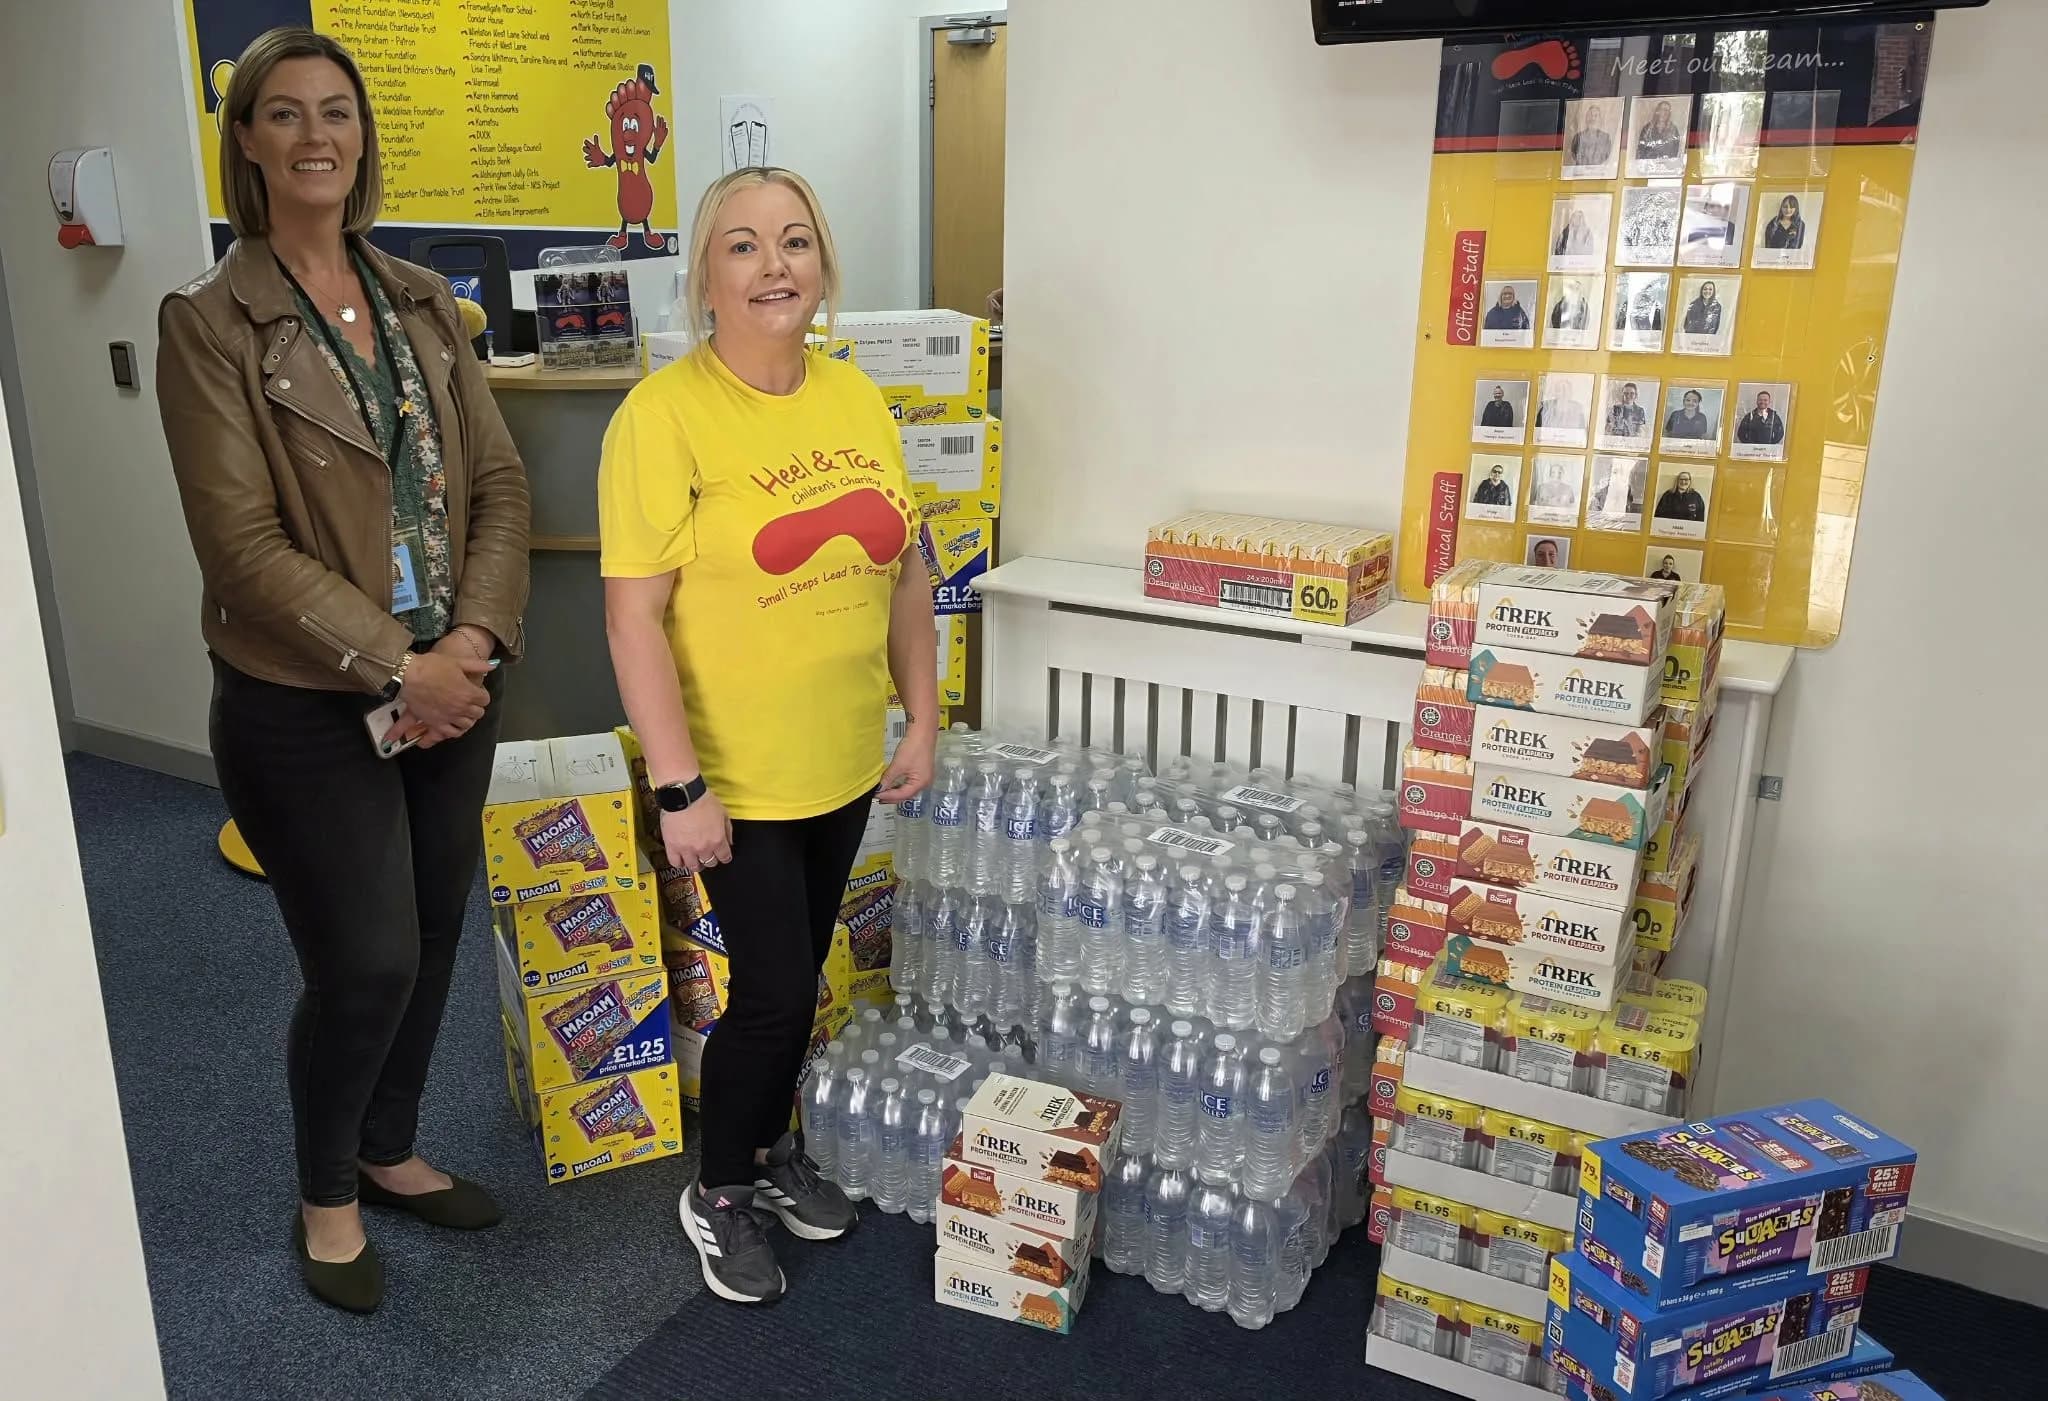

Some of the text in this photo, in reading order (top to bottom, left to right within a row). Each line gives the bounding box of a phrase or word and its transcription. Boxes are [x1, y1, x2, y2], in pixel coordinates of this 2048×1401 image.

[363, 5, 396, 16] Foundation
[341, 19, 353, 28] The
[389, 22, 420, 33] Charitable
[421, 24, 436, 33] Trust
[364, 35, 389, 44] Graham
[396, 36, 416, 46] Patron
[384, 50, 417, 60] Foundation
[1611, 56, 1676, 77] Meet
[1762, 52, 1844, 70] eam...
[386, 63, 401, 74] Ward
[434, 65, 456, 77] Charity
[373, 78, 406, 88] Foundation
[378, 92, 412, 102] Foundation
[413, 106, 445, 116] Foundation
[410, 121, 425, 130] Trust
[381, 134, 414, 143] Foundation
[388, 147, 421, 157] Foundation
[391, 161, 406, 171] Trust
[420, 187, 465, 197] Charitable Trust
[384, 203, 400, 213] Trust
[1456, 239, 1480, 342] Office Staff
[750, 448, 885, 496] Heel & Toe
[792, 475, 881, 505] Children's Charity
[1440, 479, 1457, 523] Staff
[757, 586, 789, 609] Small
[789, 575, 819, 595] Steps
[823, 565, 848, 582] Lead
[850, 565, 862, 575] To
[1148, 578, 1206, 593] Orange Juice
[941, 602, 967, 610] marked
[1300, 585, 1339, 611] 60p
[1495, 605, 1553, 627] TREK
[1485, 622, 1559, 638] PROTEIN FLAPJACKS
[1565, 676, 1625, 700] TREK
[1554, 693, 1632, 711] PROTEIN FLAPJACKS
[1420, 727, 1462, 743] Orange
[1491, 726, 1549, 749] TREK
[1481, 742, 1555, 760] PROTEIN FLAPJACKS
[1491, 782, 1547, 807] TREK
[1405, 804, 1448, 820] Orange
[1481, 798, 1552, 818] PROTEIN FLAPJACKS
[531, 812, 578, 850] MAOAM
[1008, 820, 1033, 833] ICE
[1008, 832, 1034, 840] VALLEY
[1554, 856, 1612, 880] TREK
[850, 869, 886, 889] MAOAM
[1415, 877, 1449, 894] Orang
[1543, 871, 1619, 891] PROTEIN FLAPJACKS
[518, 881, 561, 901] MAOAM
[560, 897, 605, 933] MAOAM
[848, 893, 893, 932] MAOAM
[1080, 905, 1103, 920] ICE
[699, 918, 724, 944] £1.2
[1542, 916, 1600, 942] TREK
[1391, 941, 1430, 957] Orange
[1531, 931, 1606, 953] PROTEIN FLAPJACKS
[548, 962, 588, 985] MAOAM
[671, 963, 706, 985] MAOAM
[1539, 962, 1597, 988] TREK
[1528, 976, 1602, 998] PROTEIN FLAPJACKS
[562, 994, 616, 1038] MAOAM
[1435, 1000, 1473, 1019] £1.95
[1529, 1026, 1567, 1044] £1.95
[613, 1037, 665, 1064] £1.25
[1620, 1044, 1661, 1062] £1.95
[600, 1054, 665, 1074] price marked bags
[586, 1088, 629, 1126] MAOAM
[1041, 1096, 1066, 1122] TREK
[1200, 1090, 1227, 1111] ICE
[1417, 1103, 1453, 1121] £1.95
[977, 1133, 1022, 1155] TREK
[1509, 1126, 1545, 1145] £1.95
[574, 1153, 611, 1175] MAOAM
[970, 1146, 1028, 1166] PROTEIN FLAPJACKS
[1872, 1180, 1897, 1191] great
[1008, 1205, 1036, 1219] PROTEIN
[1015, 1193, 1062, 1216] TREK
[1414, 1200, 1450, 1217] £1.95
[943, 1231, 969, 1246] PROTEIN
[949, 1220, 990, 1245] TREK
[1503, 1225, 1539, 1243] £1.95
[1736, 1248, 1758, 1260] totally
[1736, 1246, 1783, 1269] chocolatey
[943, 1288, 971, 1302] PROTEIN
[950, 1276, 993, 1299] TREK
[1395, 1287, 1430, 1306] £1.95
[1829, 1283, 1852, 1296] great
[1484, 1316, 1521, 1335] £1.95
[1703, 1357, 1724, 1369] totally
[1703, 1353, 1747, 1378] chocolatey
